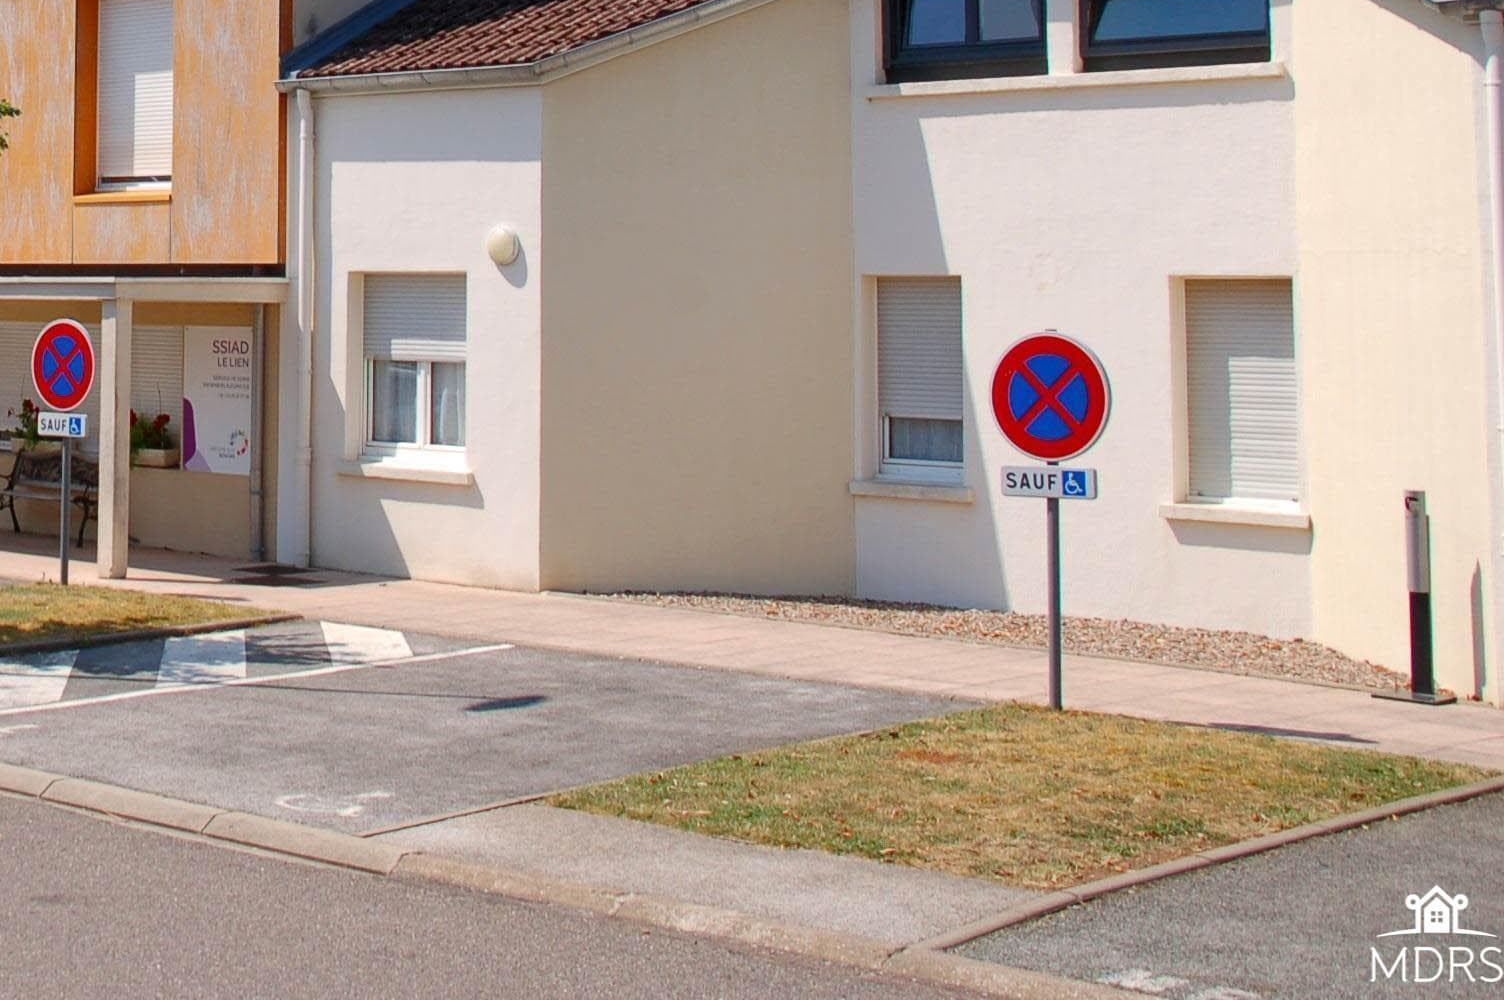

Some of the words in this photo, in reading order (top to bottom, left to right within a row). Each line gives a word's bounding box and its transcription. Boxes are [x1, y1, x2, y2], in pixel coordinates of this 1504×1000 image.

[212, 339, 250, 355] SSIAD
[217, 356, 228, 368] LE
[229, 357, 249, 368] LIEN
[40, 418, 67, 431] SAUF
[1005, 472, 1057, 490] SAUF
